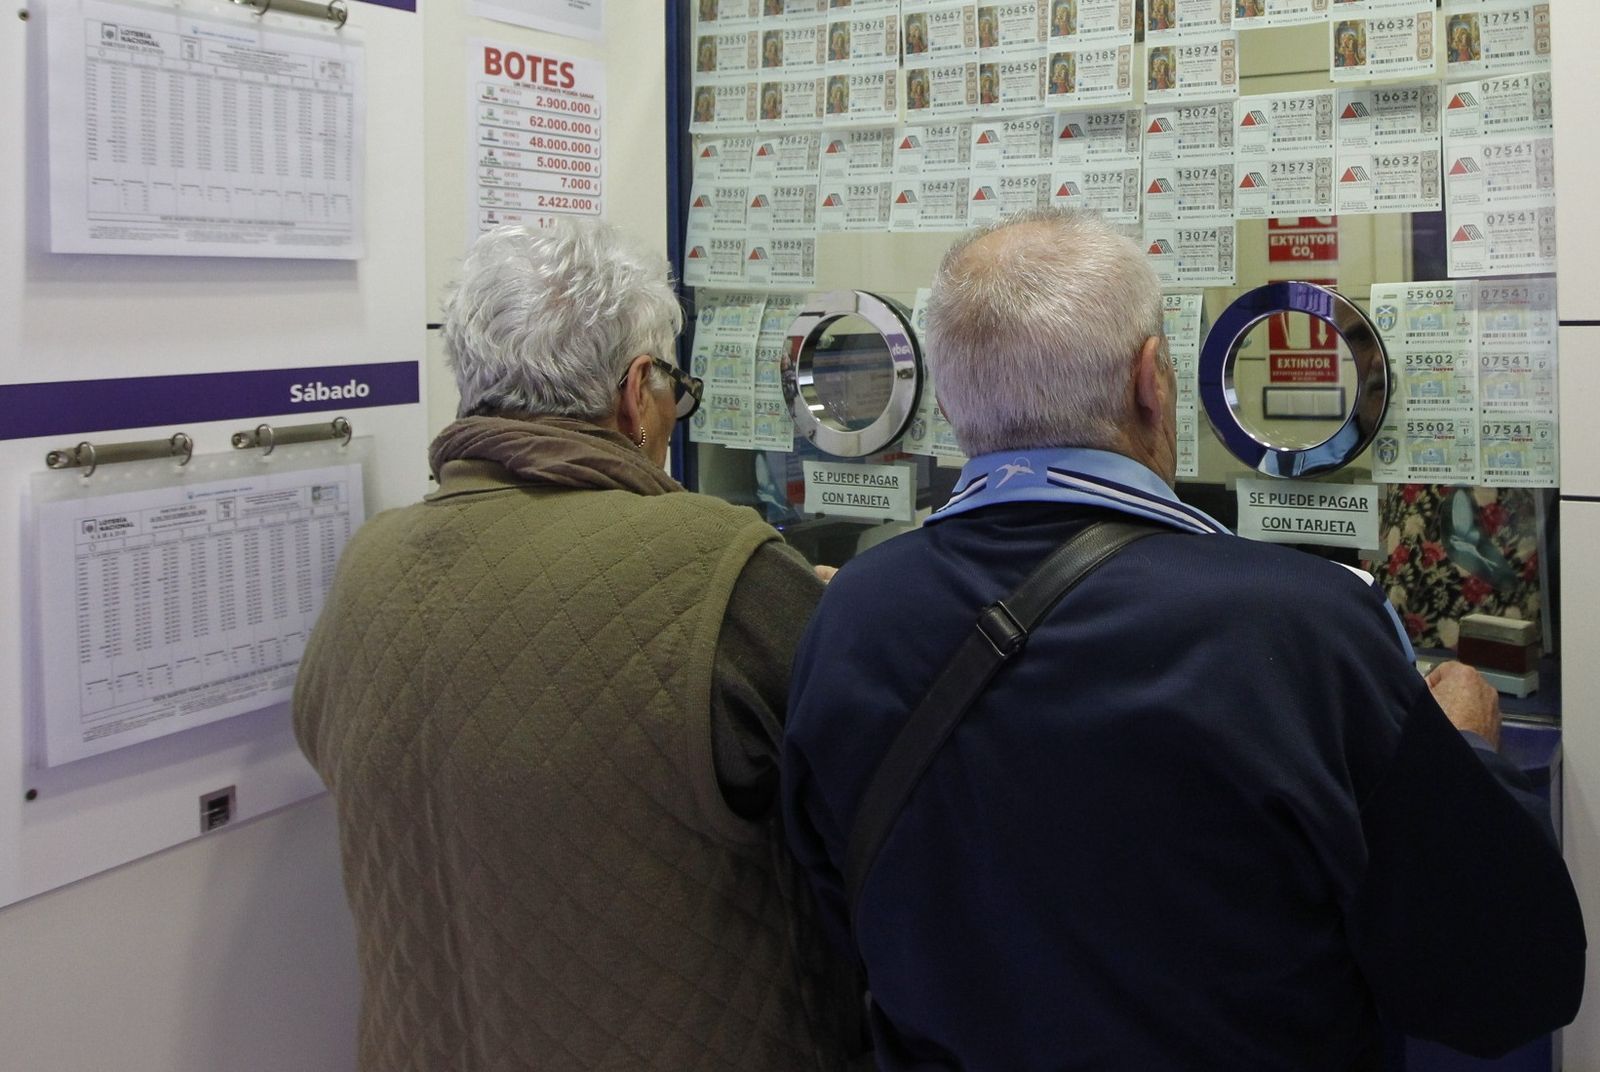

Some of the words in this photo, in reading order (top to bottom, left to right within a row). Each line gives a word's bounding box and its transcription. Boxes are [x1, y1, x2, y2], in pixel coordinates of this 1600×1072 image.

[1483, 10, 1529, 24] 17751
[1370, 18, 1414, 31] 16632
[1079, 50, 1116, 63] 16185
[1179, 45, 1218, 57] 14974
[484, 46, 575, 89] BOTES
[931, 67, 964, 79] 16447
[1001, 63, 1037, 74] 26456
[1482, 78, 1529, 91] 07541
[1375, 90, 1418, 102] 16632
[536, 95, 591, 114] 2.900.000
[1272, 99, 1314, 110] 21573
[1087, 113, 1125, 125] 20375
[1178, 107, 1216, 119] 13074
[529, 115, 591, 134] 62.000.000
[1003, 121, 1040, 131] 26456
[529, 136, 591, 154] 48.000.000
[1484, 144, 1532, 157] 07541
[537, 156, 591, 172] 5.000.000
[1375, 155, 1419, 166] 16632
[1178, 168, 1216, 179] 13074
[1271, 162, 1313, 173] 21573
[561, 177, 591, 190] 7.000
[1000, 177, 1037, 188] 26456
[1085, 172, 1122, 183] 20375
[922, 181, 955, 192] 16447
[538, 195, 592, 210] 2.422.000
[1487, 212, 1535, 225] 07541
[1177, 230, 1216, 241] 13074
[1270, 234, 1336, 246] EXTINTOR
[1407, 289, 1453, 299] 55602
[1481, 288, 1529, 299] 07541
[1277, 358, 1331, 369] EXTINTOR
[1406, 354, 1452, 365] 55602
[1481, 355, 1529, 366] 07541
[290, 380, 370, 403] Sábado
[1407, 422, 1454, 432] 55602
[1482, 424, 1531, 435] 07541
[813, 471, 824, 482] SE
[827, 471, 860, 484] PUEDE
[863, 474, 899, 487] PAGAR
[822, 491, 844, 503] CON
[846, 493, 890, 507] TARJETA
[1249, 492, 1266, 504] SE
[1269, 492, 1314, 507] PUEDE
[1319, 495, 1368, 510] PAGAR
[1262, 516, 1293, 530] CON
[1296, 518, 1356, 534] TARJETA
